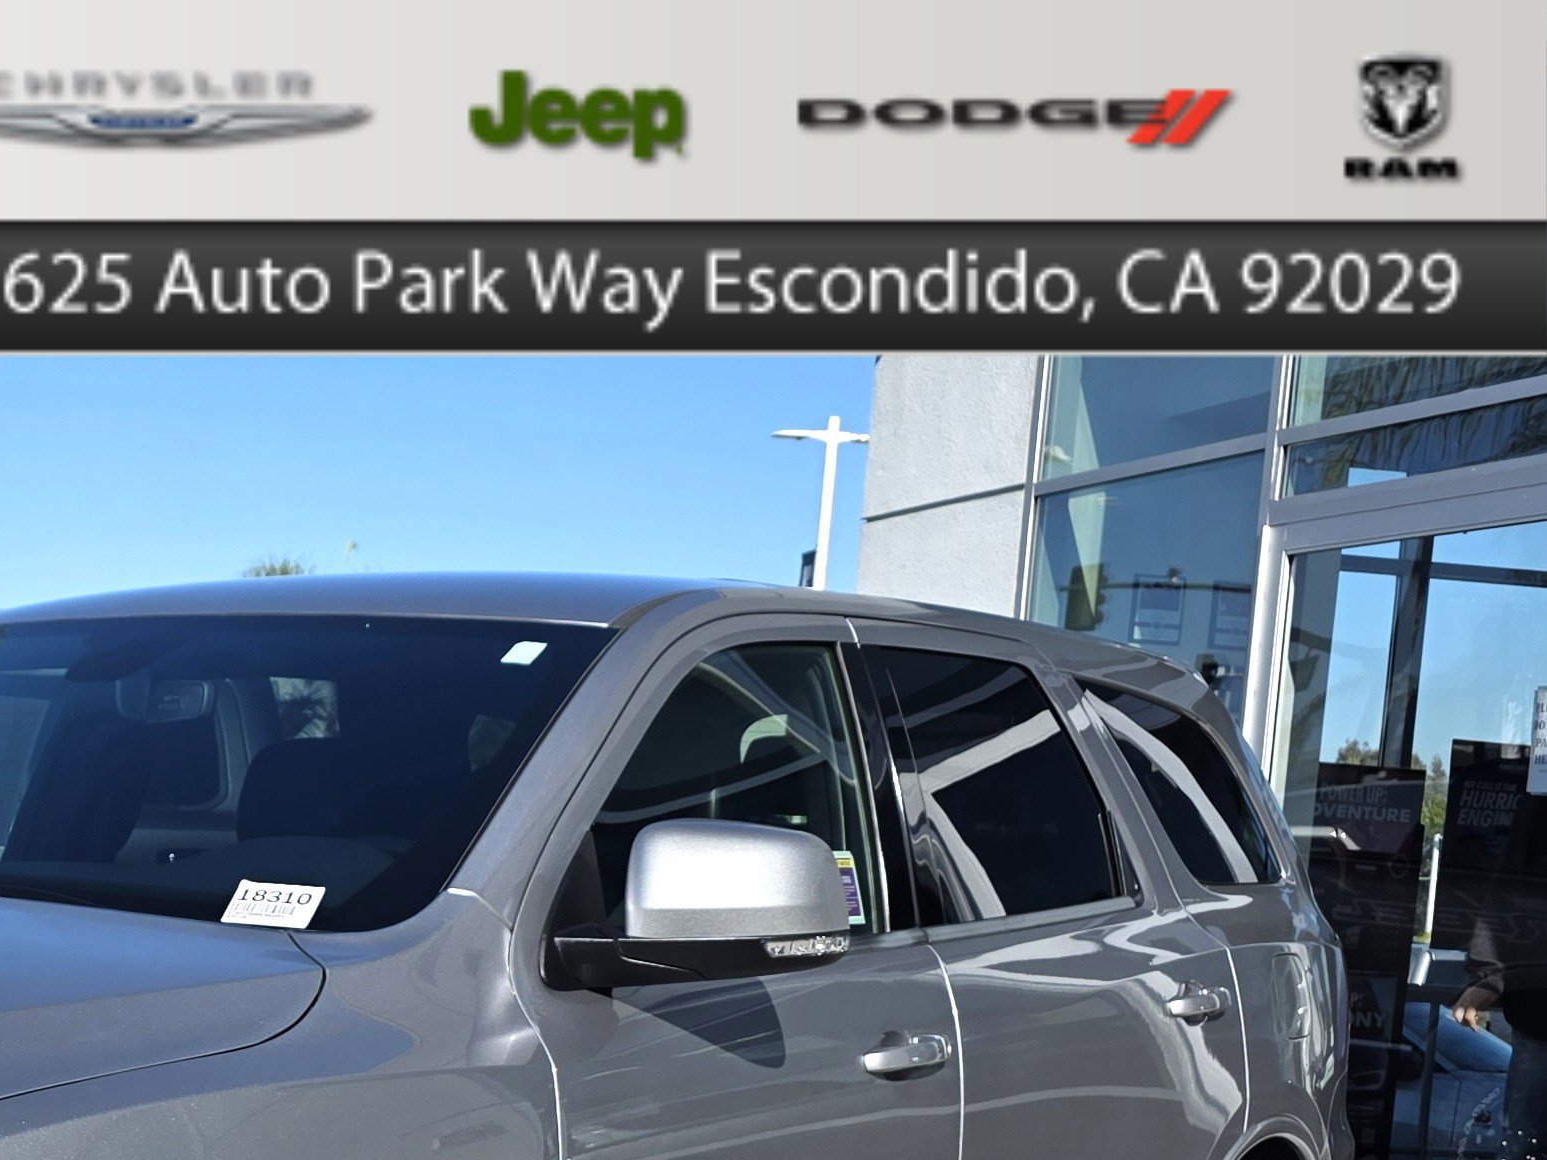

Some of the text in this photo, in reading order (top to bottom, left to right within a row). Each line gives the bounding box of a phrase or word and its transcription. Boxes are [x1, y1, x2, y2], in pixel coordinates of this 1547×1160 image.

[1459, 790, 1523, 810] HURRIC
[1314, 803, 1411, 822] DVENTURE
[1457, 809, 1513, 827] ENGIN
[238, 889, 312, 905] 18310
